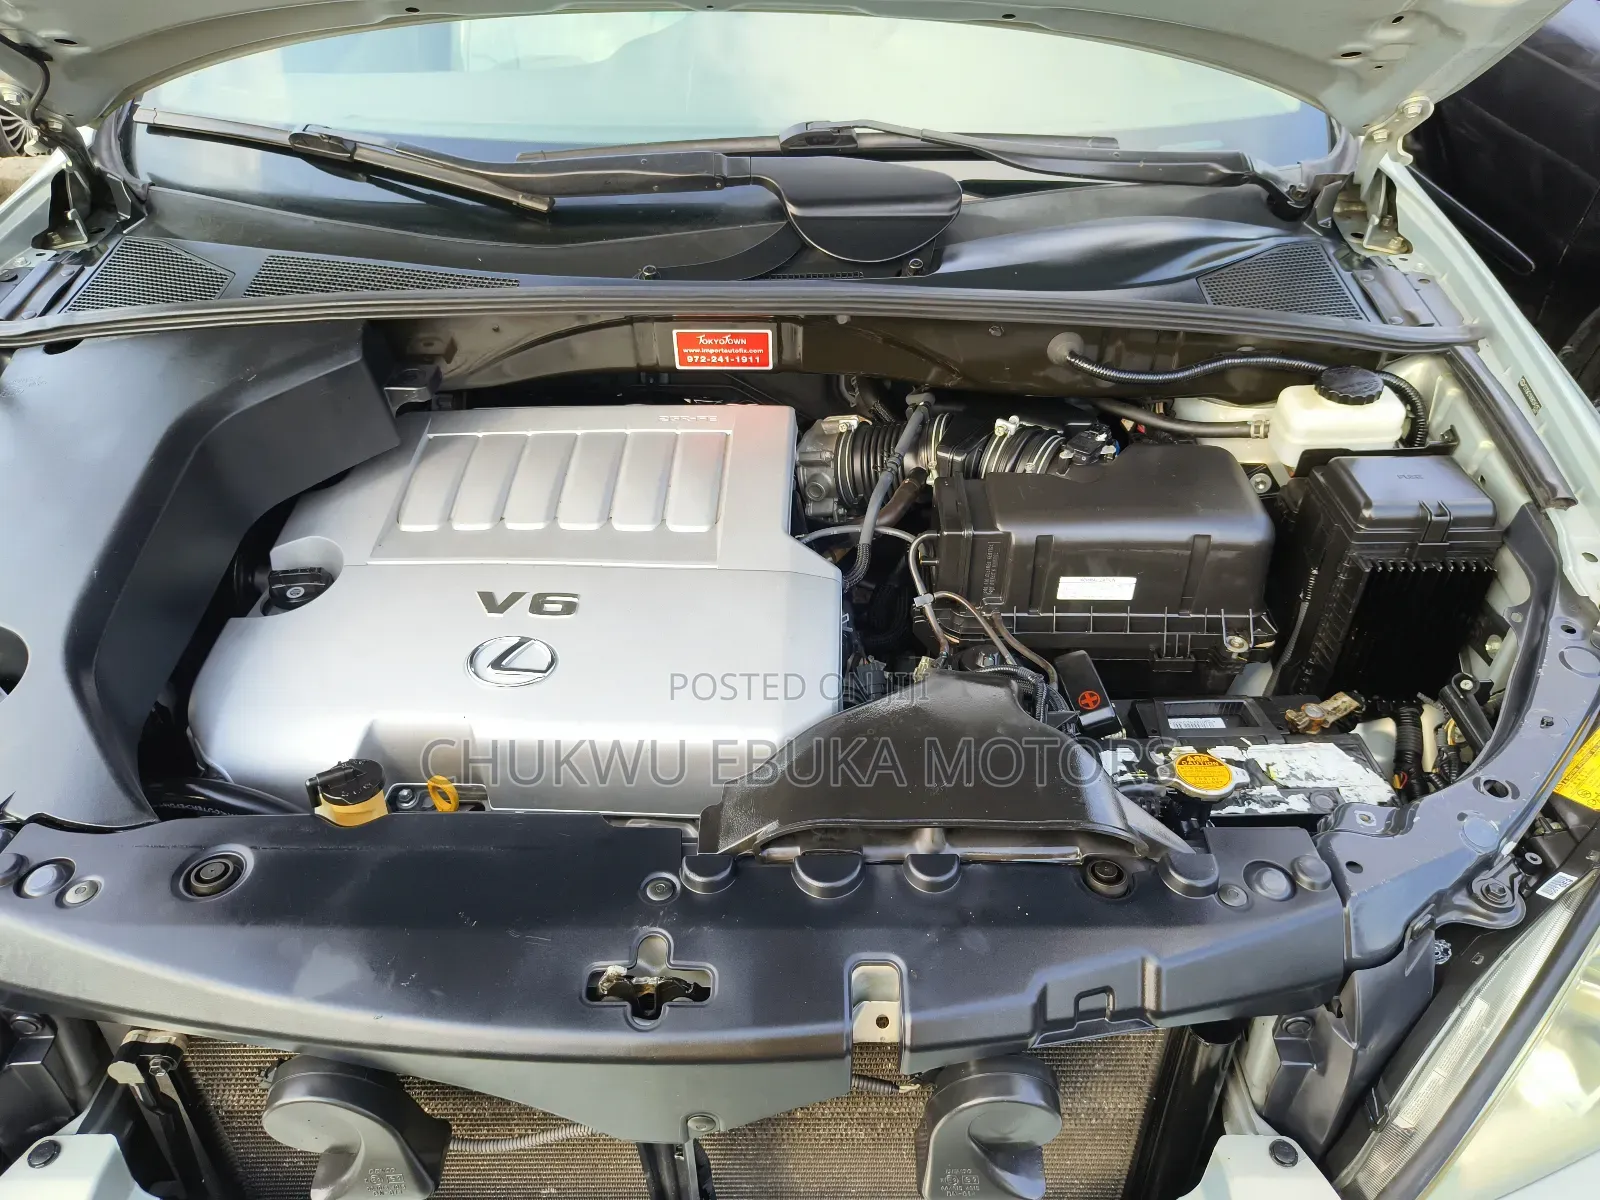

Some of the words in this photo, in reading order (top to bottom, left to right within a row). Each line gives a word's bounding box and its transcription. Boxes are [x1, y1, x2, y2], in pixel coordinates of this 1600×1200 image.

[682, 347, 764, 355] www.importautofix.com
[686, 355, 760, 363] 972-241-1911
[476, 591, 580, 618] V6
